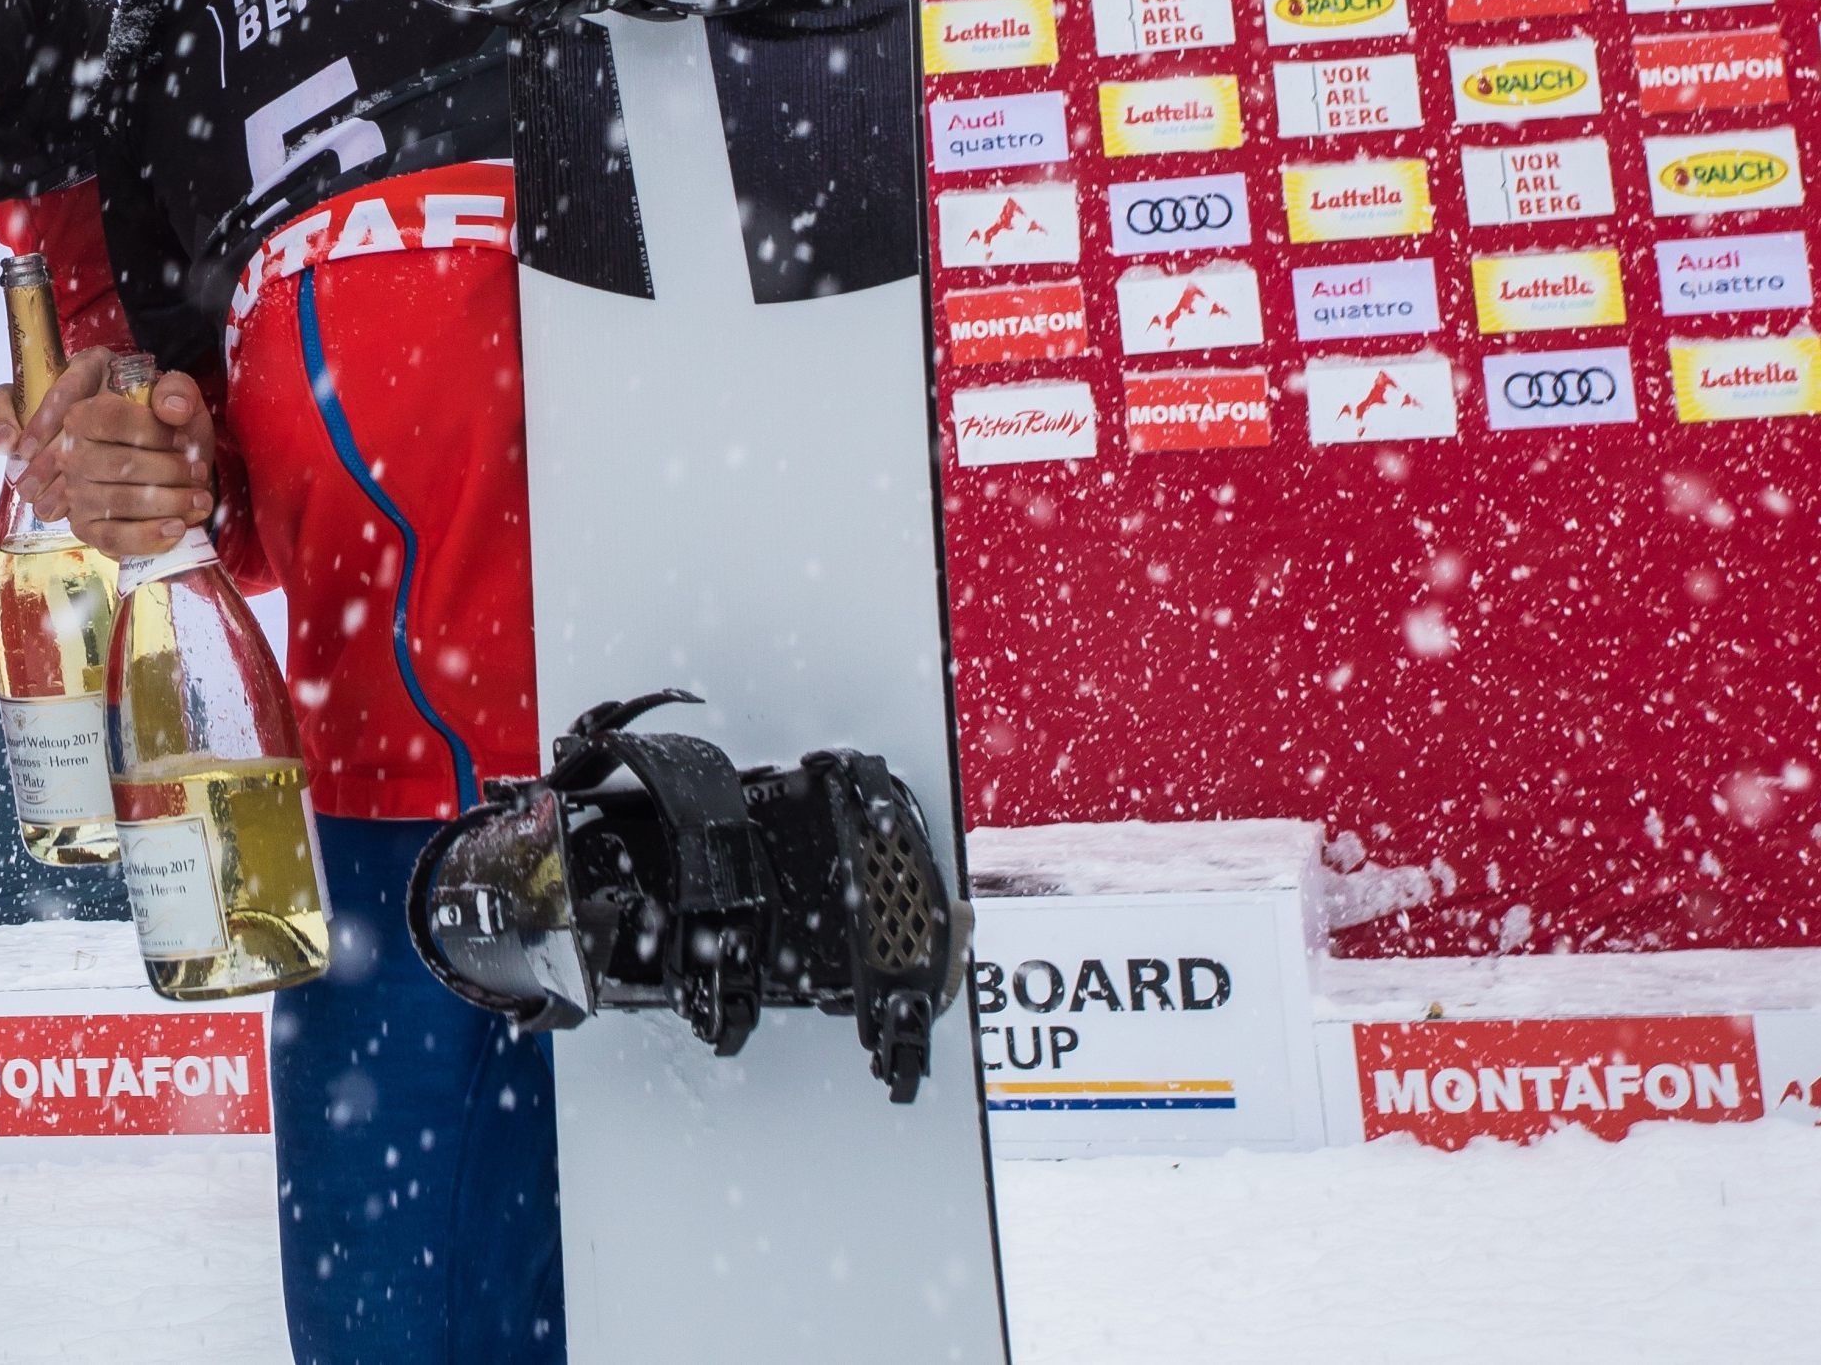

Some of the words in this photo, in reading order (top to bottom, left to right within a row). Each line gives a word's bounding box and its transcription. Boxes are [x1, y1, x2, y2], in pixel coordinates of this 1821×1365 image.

[1142, 7, 1185, 25] ARL
[942, 18, 1031, 43] Lattella
[1145, 25, 1205, 46] BERG
[1323, 66, 1371, 86] VOR
[1494, 69, 1576, 95] RAUCH
[1640, 57, 1784, 89] MONTAFON
[1325, 87, 1370, 106] ARL
[947, 109, 1005, 132] Audi
[1124, 100, 1215, 125] Lattella
[1328, 107, 1390, 129] BERG
[244, 56, 387, 230] 5
[949, 132, 1044, 158] quattro
[1511, 153, 1561, 173] VOR
[1693, 160, 1775, 186] RAUCH
[1515, 175, 1561, 194] ARL
[1309, 185, 1403, 211] Lattella
[1518, 194, 1582, 216] BERG
[1676, 250, 1741, 273] Audi
[1311, 276, 1373, 299] Audi
[1498, 278, 1595, 302] Lattella
[1678, 274, 1785, 299] quattro
[1313, 299, 1414, 324] quattro
[950, 311, 1083, 341] MONTAFON
[1699, 362, 1799, 389] Lattella
[1128, 402, 1267, 426] MONTAFON
[26, 734, 71, 750] Weltcup
[72, 731, 99, 747] 2017
[49, 754, 90, 768] Herren
[22, 772, 46, 789] Platz
[130, 861, 169, 878] Weltcup
[170, 858, 195, 874] 2017
[975, 957, 1232, 1014] BOARD
[1375, 1063, 1740, 1116] MONTAFON
